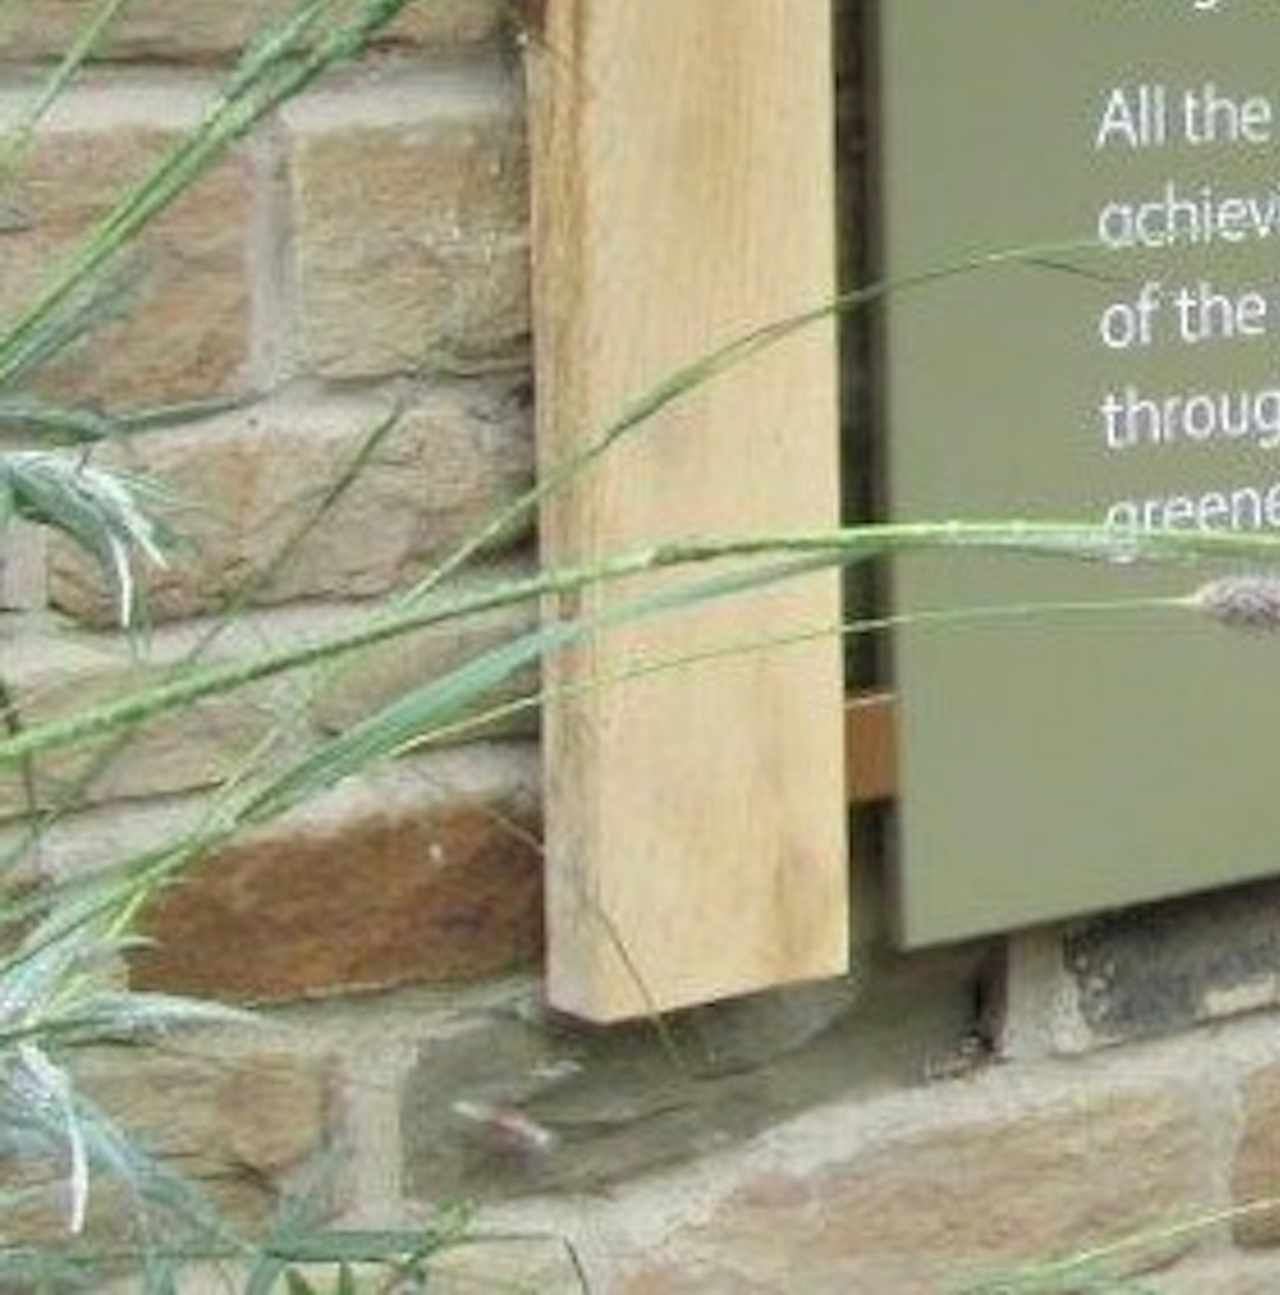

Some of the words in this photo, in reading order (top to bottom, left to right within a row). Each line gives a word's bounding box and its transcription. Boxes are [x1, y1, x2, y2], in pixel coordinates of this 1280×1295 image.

[1096, 86, 1166, 149] All
[1184, 86, 1270, 145] the
[1100, 281, 1159, 350] of
[1178, 282, 1266, 342] the
